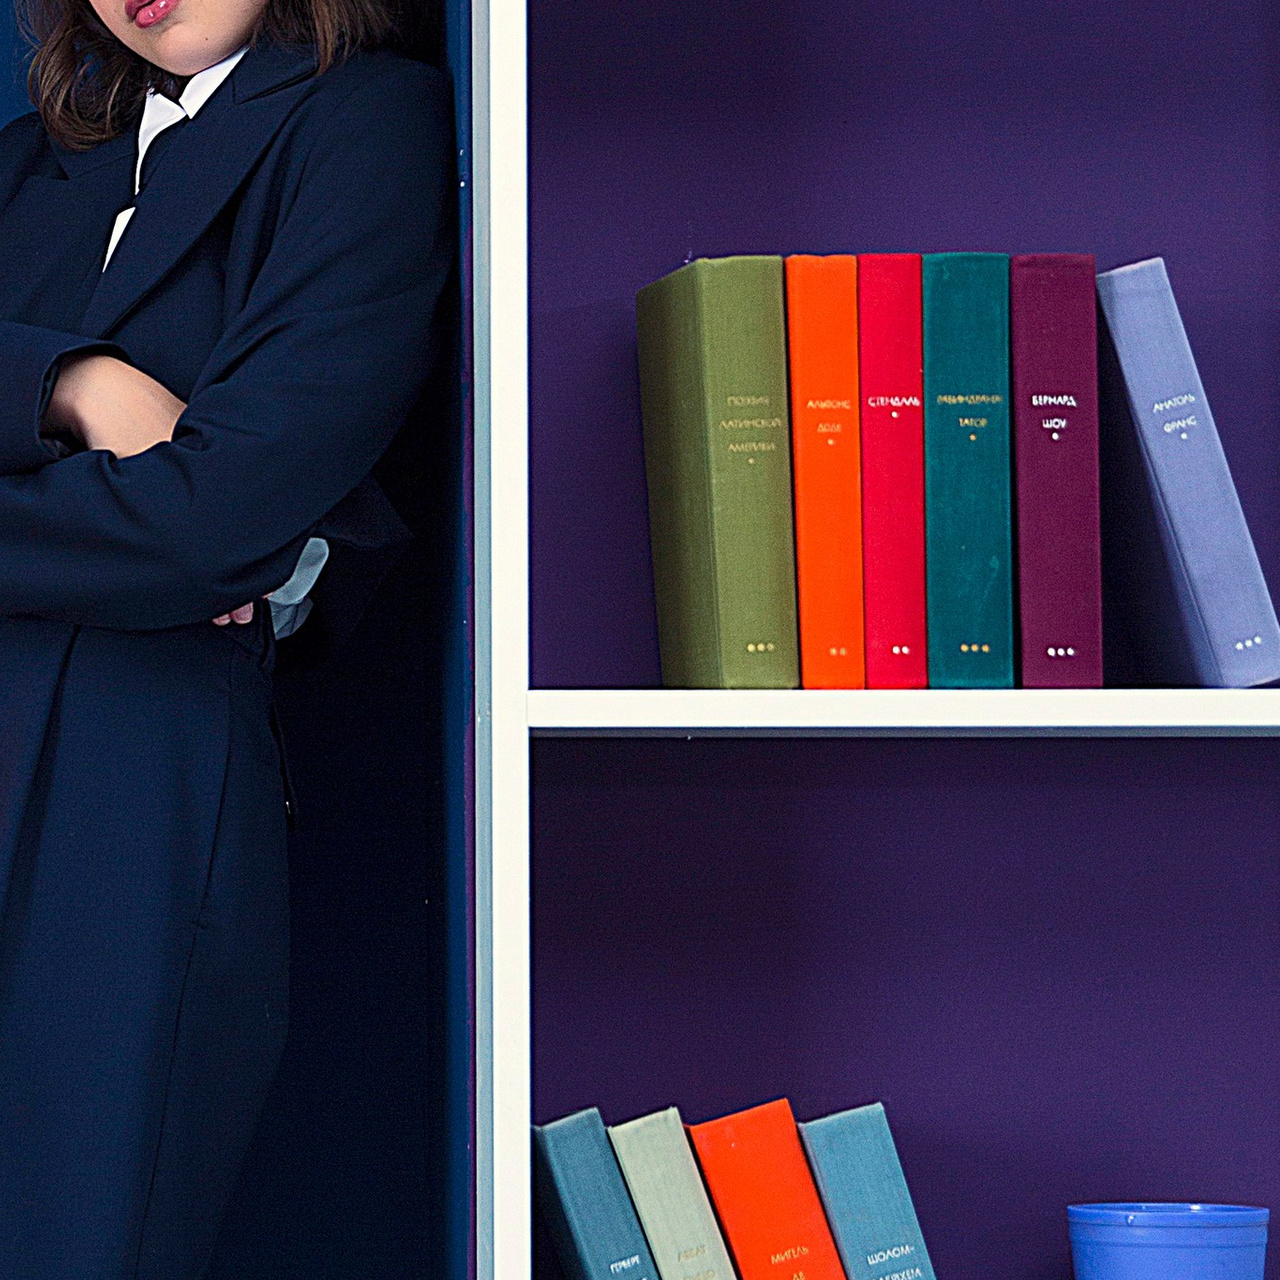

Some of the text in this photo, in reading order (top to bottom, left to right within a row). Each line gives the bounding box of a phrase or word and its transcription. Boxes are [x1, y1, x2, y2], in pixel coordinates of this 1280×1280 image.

[807, 399, 850, 409] АЛЬФОНС
[868, 396, 920, 407] СТЕНДАЛЬ
[1031, 395, 1076, 407] БЕРНАРД
[1153, 394, 1195, 413] АНАТОЛЬ
[818, 423, 842, 433] ДОДЕ
[1042, 419, 1067, 429] ШОУ
[1164, 416, 1196, 433] ФРАНС
[771, 1246, 809, 1264] МИГЕЛЬ
[867, 1245, 914, 1265] ШОЛОМ-
[610, 1255, 640, 1273] ГЕРБЕРТ
